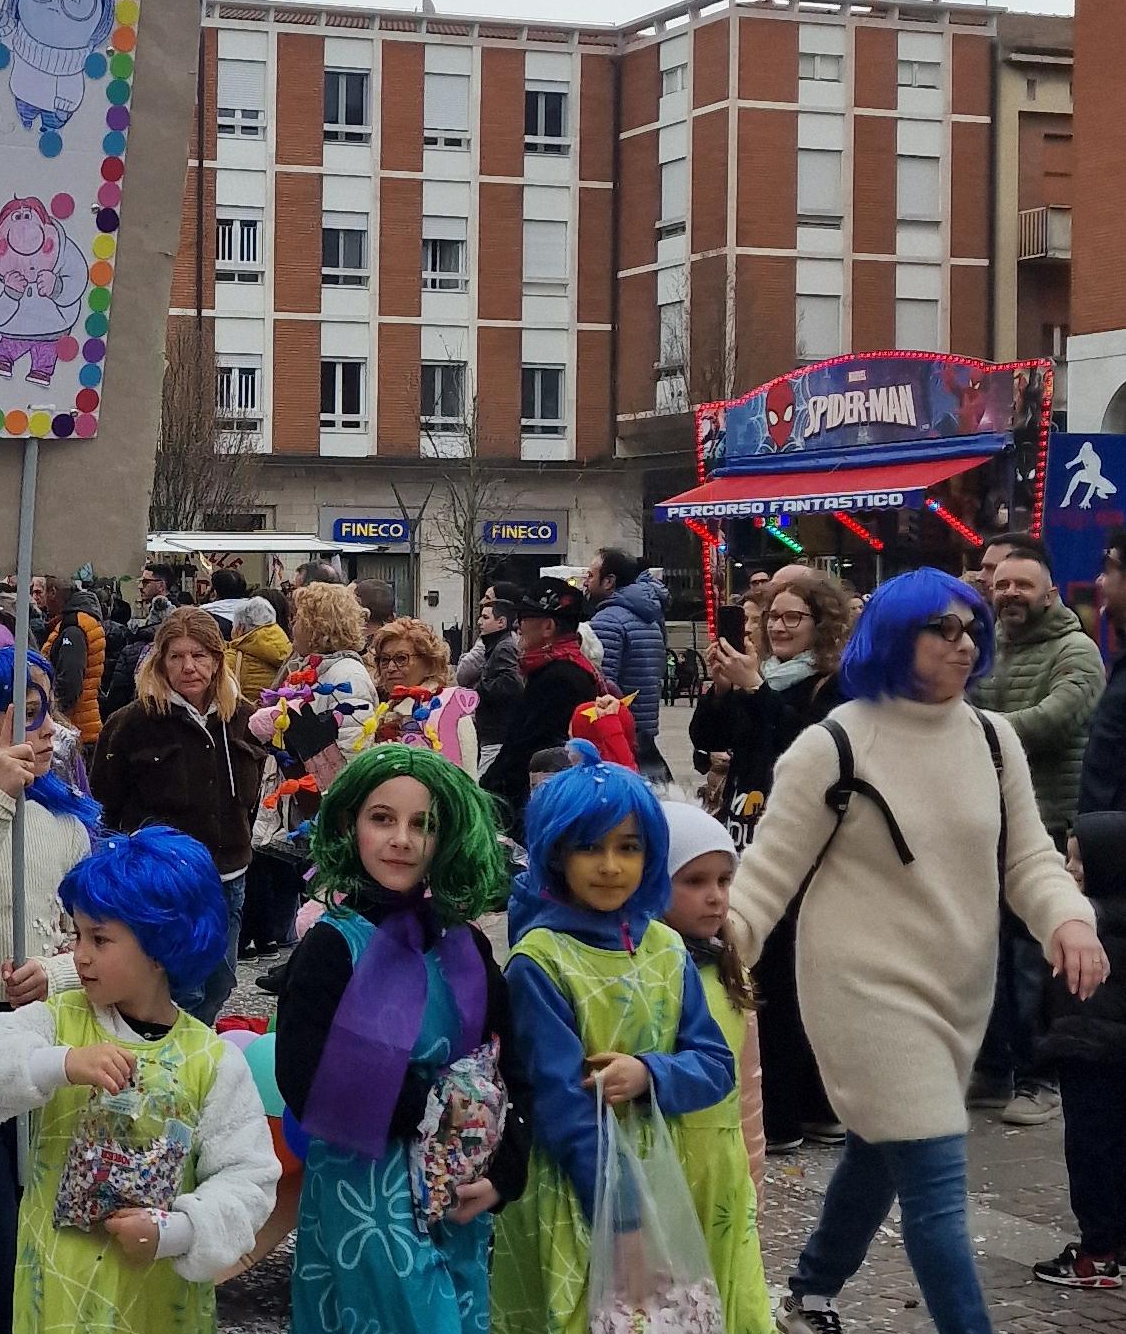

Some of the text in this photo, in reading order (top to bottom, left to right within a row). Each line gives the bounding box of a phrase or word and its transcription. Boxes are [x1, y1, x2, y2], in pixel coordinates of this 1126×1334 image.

[804, 384, 917, 438] SPIDER-MAN
[667, 494, 904, 518] PERCORSO FANTASTICO
[341, 523, 404, 538] FINECO
[491, 524, 552, 539] FINECO
